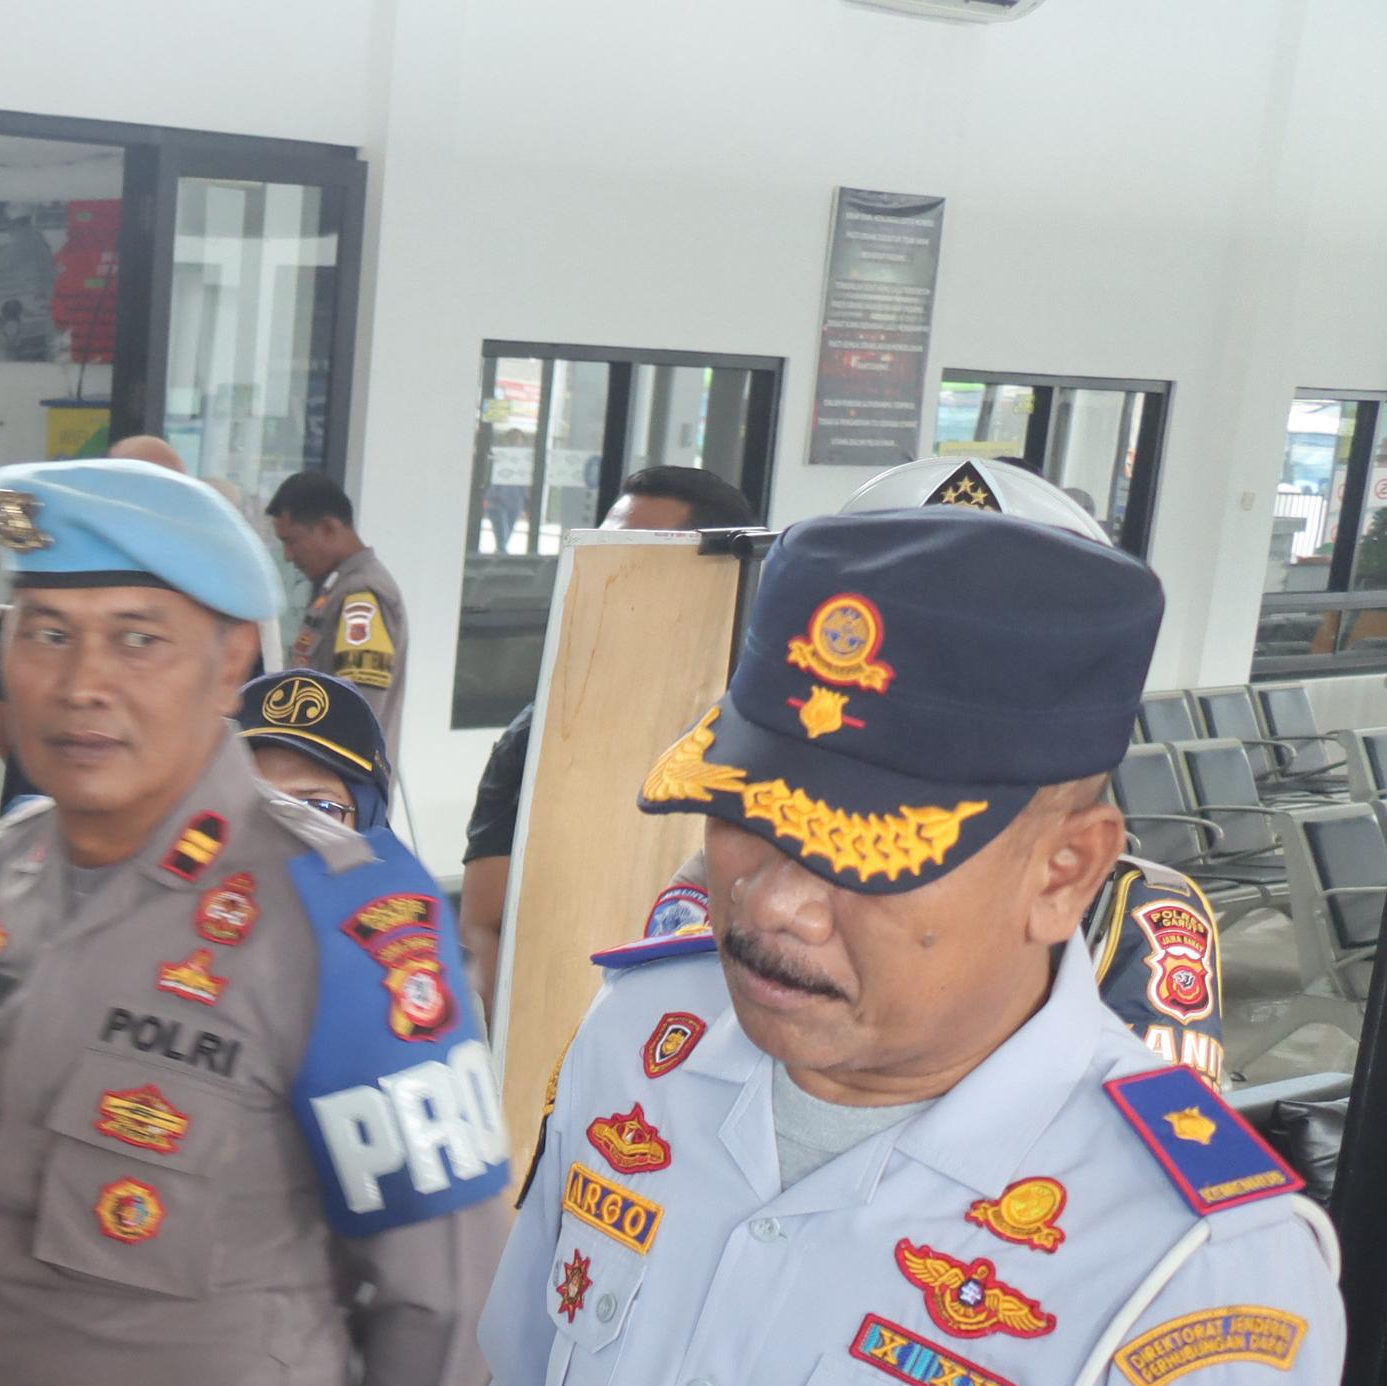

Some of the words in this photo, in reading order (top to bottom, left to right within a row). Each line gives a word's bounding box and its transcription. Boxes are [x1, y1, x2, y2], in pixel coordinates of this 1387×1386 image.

[1150, 909, 1205, 934] POLRES
[1161, 916, 1198, 934] GARUT
[98, 1006, 241, 1078] POLRI
[570, 1172, 647, 1239] ARGO
